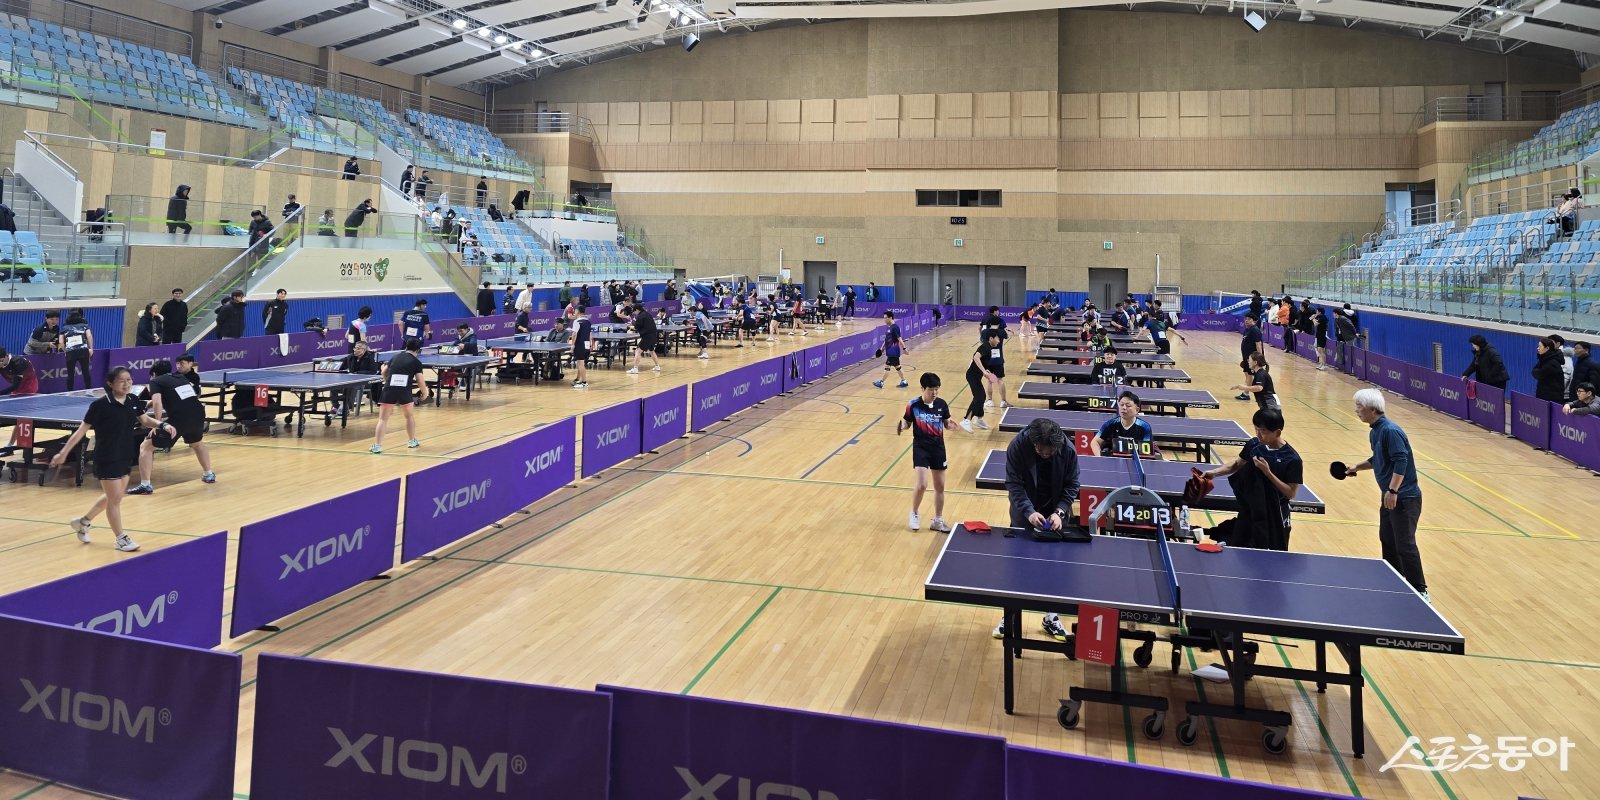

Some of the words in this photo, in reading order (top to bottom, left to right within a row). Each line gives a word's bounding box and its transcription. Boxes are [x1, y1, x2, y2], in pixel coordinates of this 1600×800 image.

[316, 340, 345, 350] XIOM
[212, 350, 247, 361] XIOM
[256, 387, 267, 399] 16
[1088, 398, 1099, 407] 10
[18, 423, 31, 437] 15
[1558, 423, 1588, 444] XIOM
[1080, 434, 1089, 449] 3
[1141, 442, 1151, 454] 0
[1088, 494, 1098, 512] 2
[1116, 504, 1136, 522] 14
[1136, 509, 1151, 520] 20
[1152, 507, 1171, 525] 13
[1120, 611, 1141, 620] PRO
[1093, 614, 1104, 641] 1
[1375, 637, 1452, 651] CHAMPION
